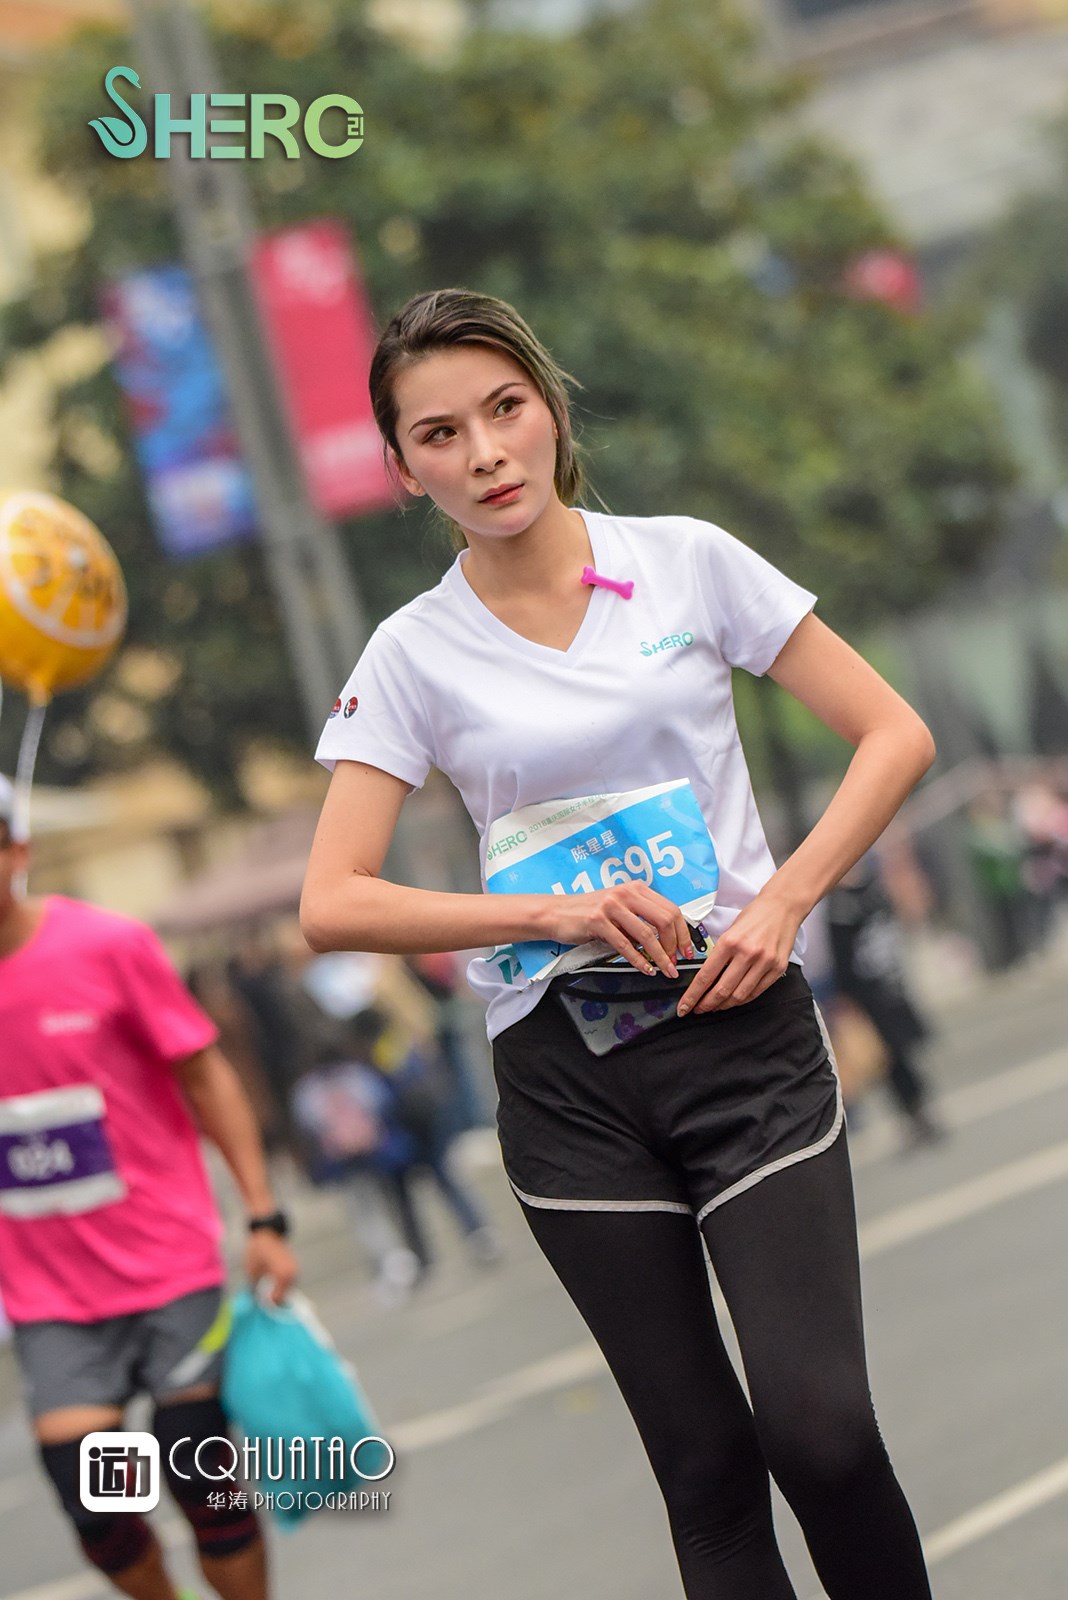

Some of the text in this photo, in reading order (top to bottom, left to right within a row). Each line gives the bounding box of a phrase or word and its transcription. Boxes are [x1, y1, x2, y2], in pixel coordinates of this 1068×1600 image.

[640, 631, 694, 657] SHERO
[570, 829, 618, 864] 陈星星
